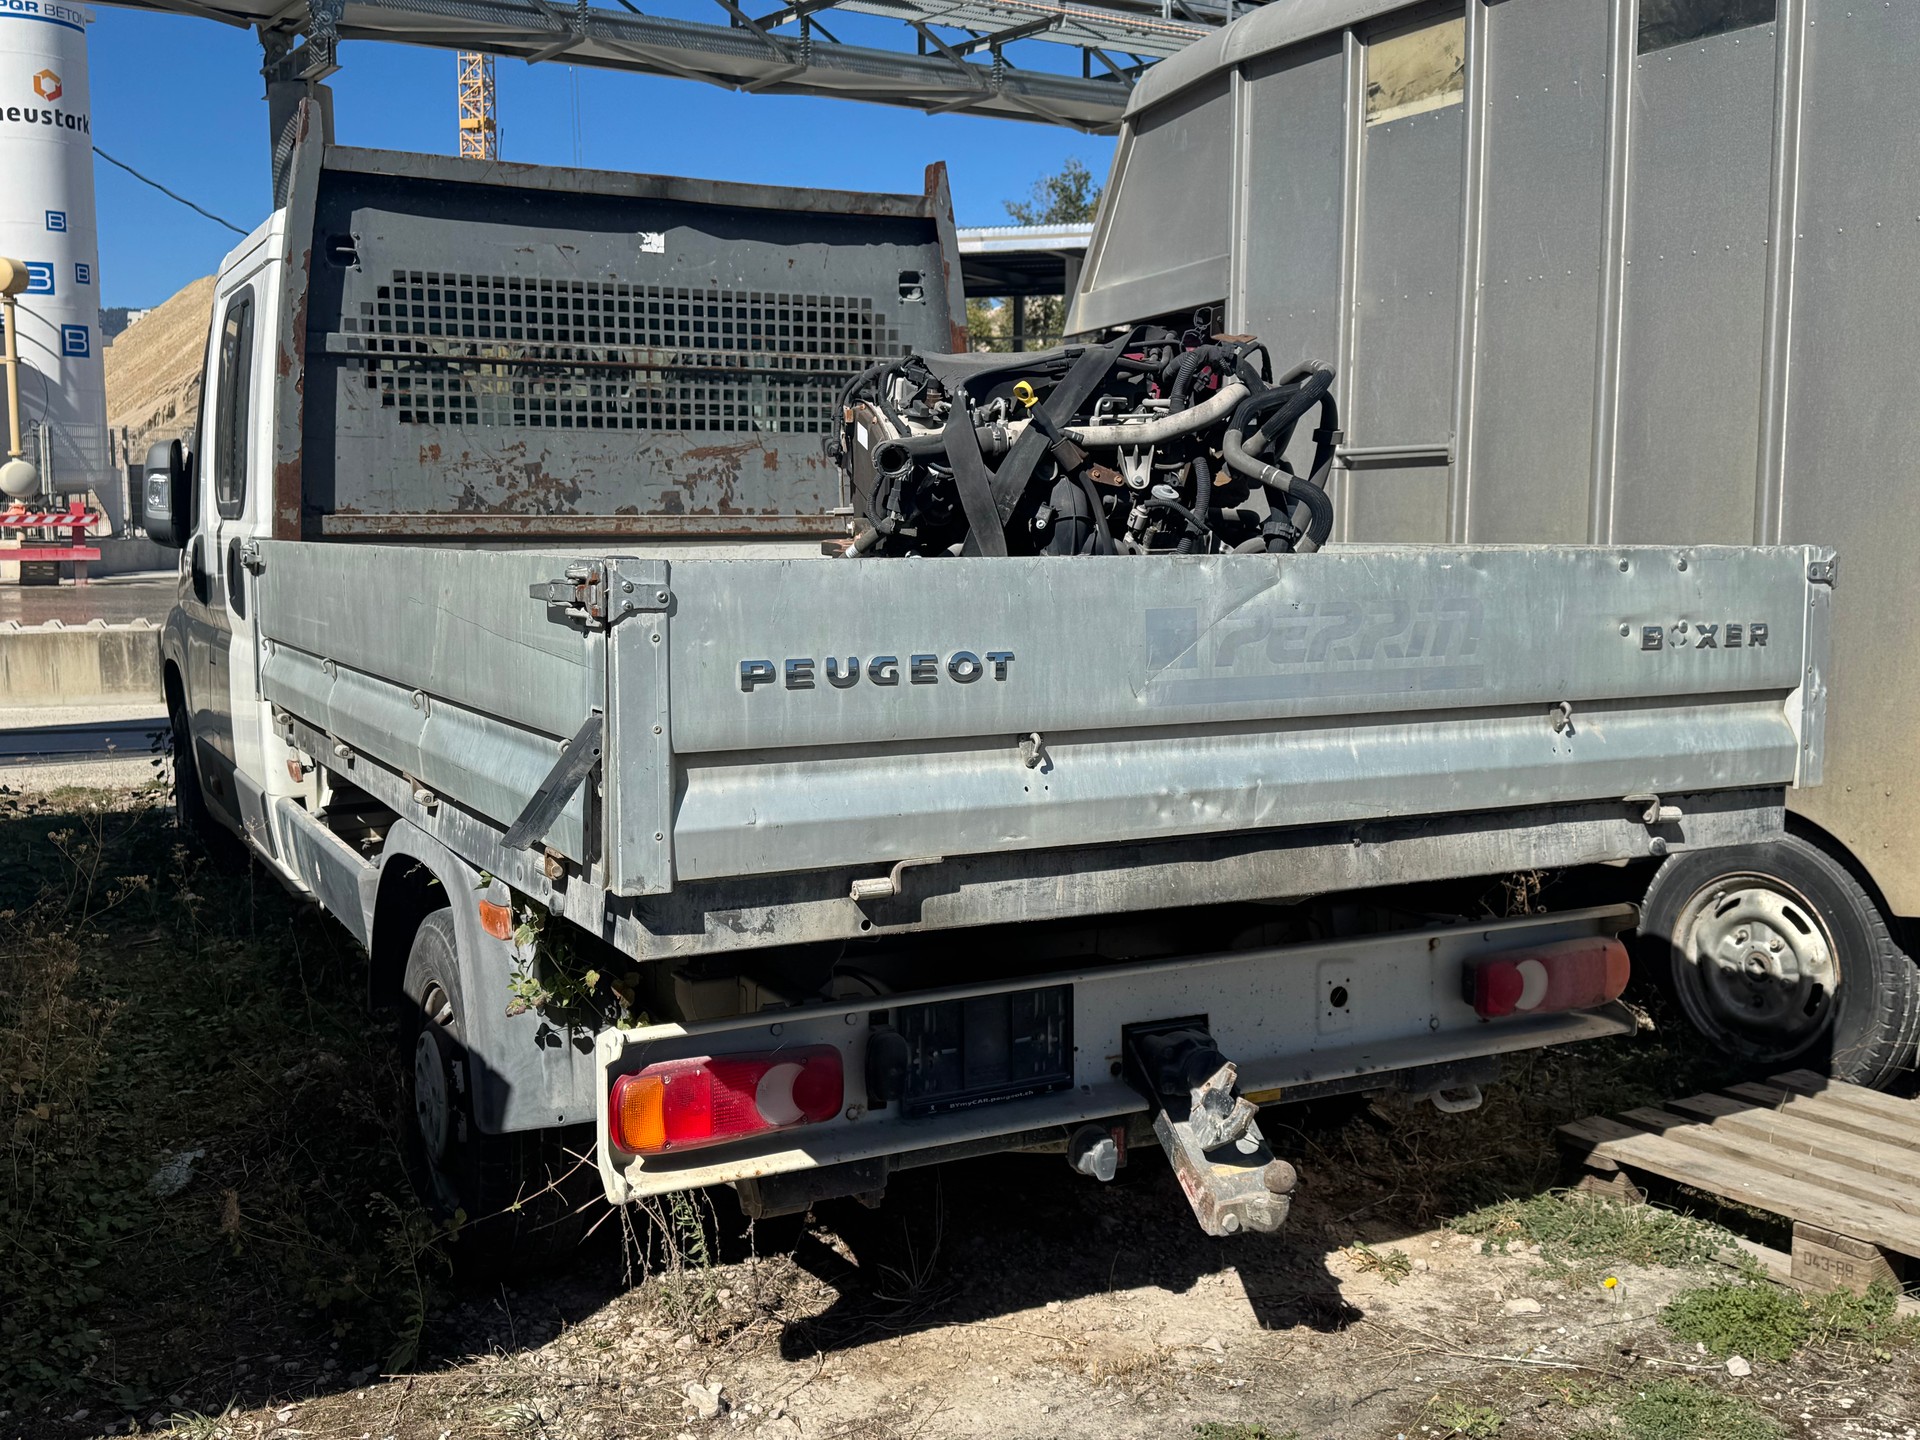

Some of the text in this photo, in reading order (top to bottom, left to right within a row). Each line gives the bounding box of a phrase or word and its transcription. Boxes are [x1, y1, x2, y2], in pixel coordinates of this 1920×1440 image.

[0, 106, 90, 135] eustark
[48, 212, 65, 230] B
[77, 266, 90, 282] B
[65, 329, 88, 353] B
[740, 651, 1015, 692] PEUGEOT
